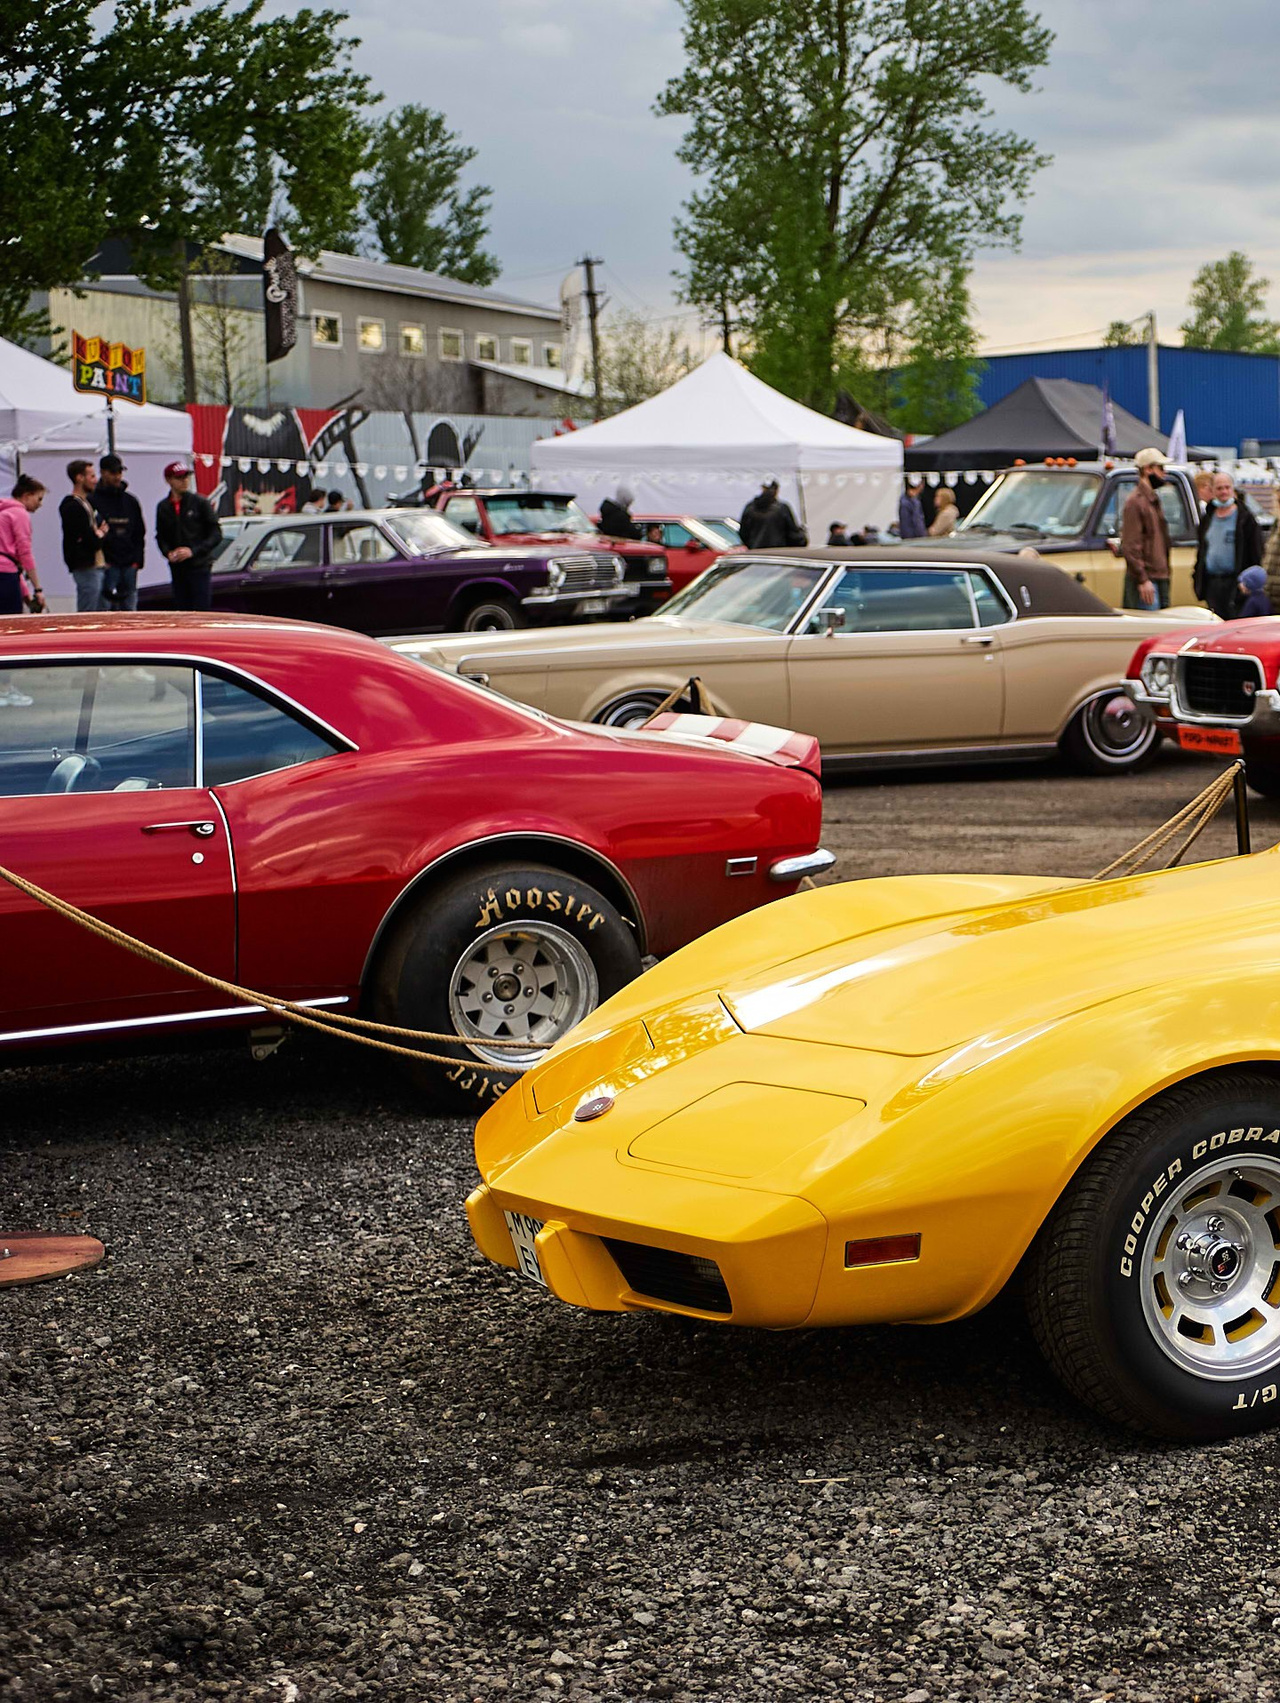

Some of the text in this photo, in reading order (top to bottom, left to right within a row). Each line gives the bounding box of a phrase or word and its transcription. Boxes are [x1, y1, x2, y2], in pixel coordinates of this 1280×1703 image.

[80, 365, 141, 395] PAINT
[475, 887, 605, 930] Hoosier
[1120, 1127, 1280, 1278] COOPER COBRA
[1232, 1384, 1278, 1410] G/T
